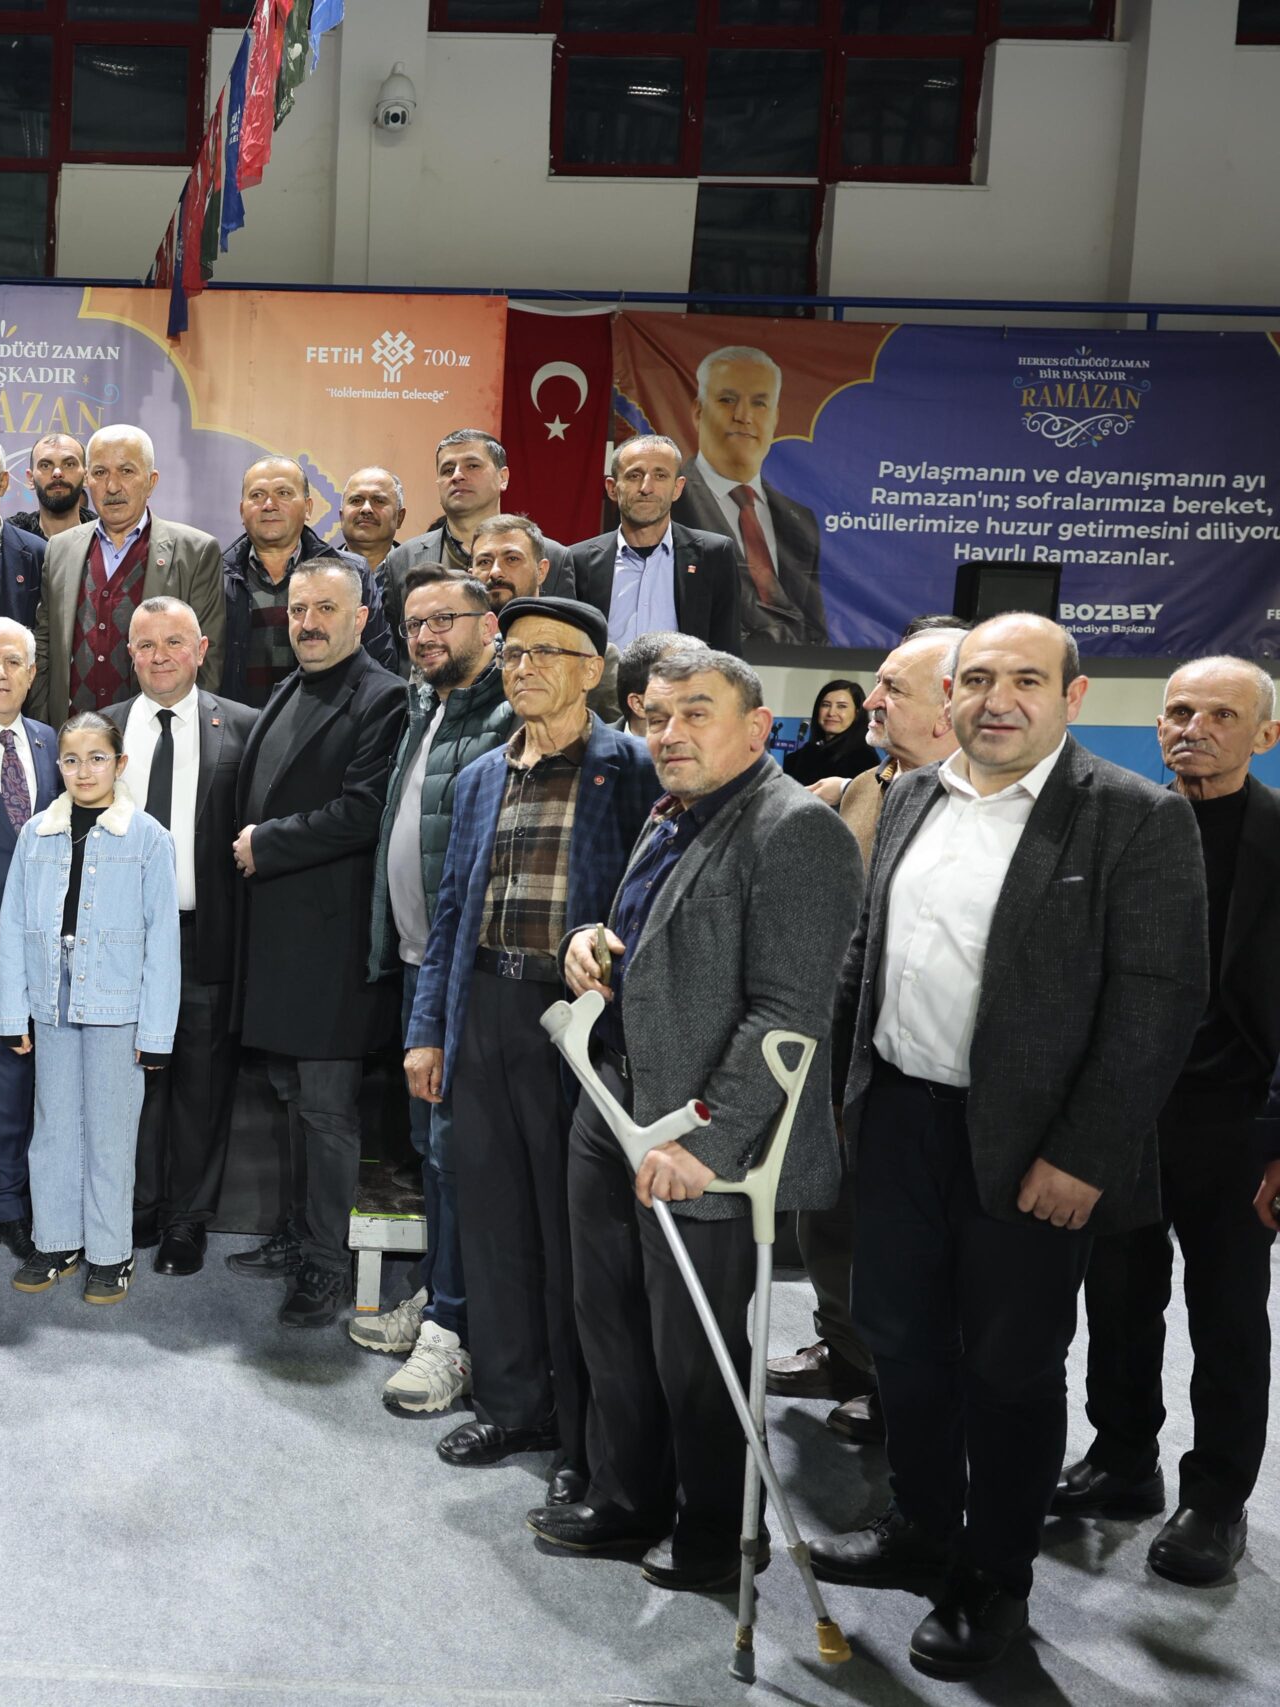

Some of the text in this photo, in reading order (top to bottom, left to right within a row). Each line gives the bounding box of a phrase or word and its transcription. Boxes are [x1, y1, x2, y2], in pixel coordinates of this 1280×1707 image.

[51, 345, 120, 360] ZAMAN
[1018, 356, 1150, 368] HERKES GÜLDÜĞÜ ZAMAN
[1039, 368, 1126, 382] BİR BAŞKADIR
[1020, 383, 1142, 409] RAMAZAN
[878, 460, 1266, 493] Paylaşmanın ve dayanışmanın ayı
[871, 487, 1273, 516] Ramazan'ın; sofralarımıza bereket,
[825, 511, 980, 532] gönüllerimize
[985, 516, 1053, 536] huzur
[1058, 519, 1190, 541] getirmesini
[1033, 545, 1175, 566] Ramazanlar.
[1060, 603, 1164, 620] BOZBEY
[1112, 624, 1155, 635] Başkanı
